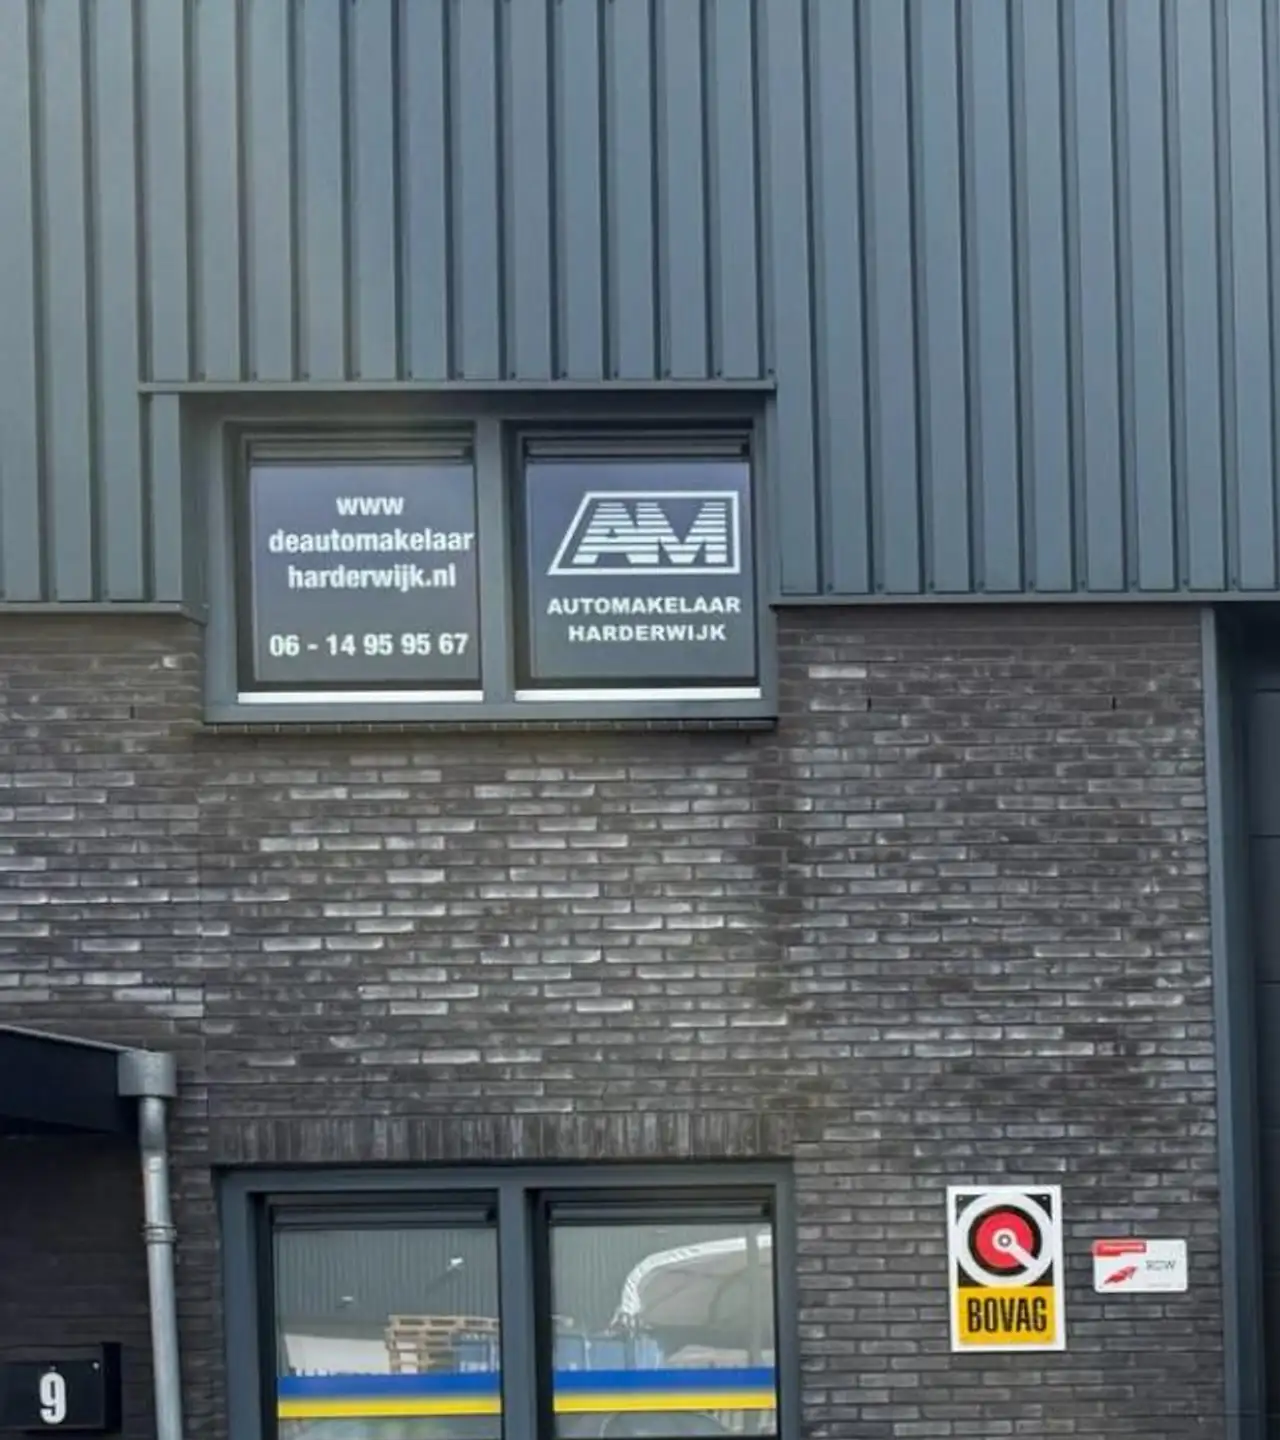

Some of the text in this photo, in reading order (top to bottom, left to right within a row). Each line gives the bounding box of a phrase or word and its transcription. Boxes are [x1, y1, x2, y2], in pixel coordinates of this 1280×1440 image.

[336, 496, 404, 516] www
[268, 527, 475, 553] deautomakelaar
[571, 501, 727, 565] AM
[288, 562, 457, 593] harderwijk.nl
[546, 596, 741, 616] AUTOMAKELAAR
[269, 634, 300, 656] 06
[326, 633, 356, 656] 14
[363, 633, 394, 656] 95
[401, 632, 432, 655] 95
[438, 632, 469, 655] 67
[568, 624, 727, 642] HARDERWIJK
[967, 1297, 1047, 1333] BOVAG
[40, 1371, 67, 1424] 9
